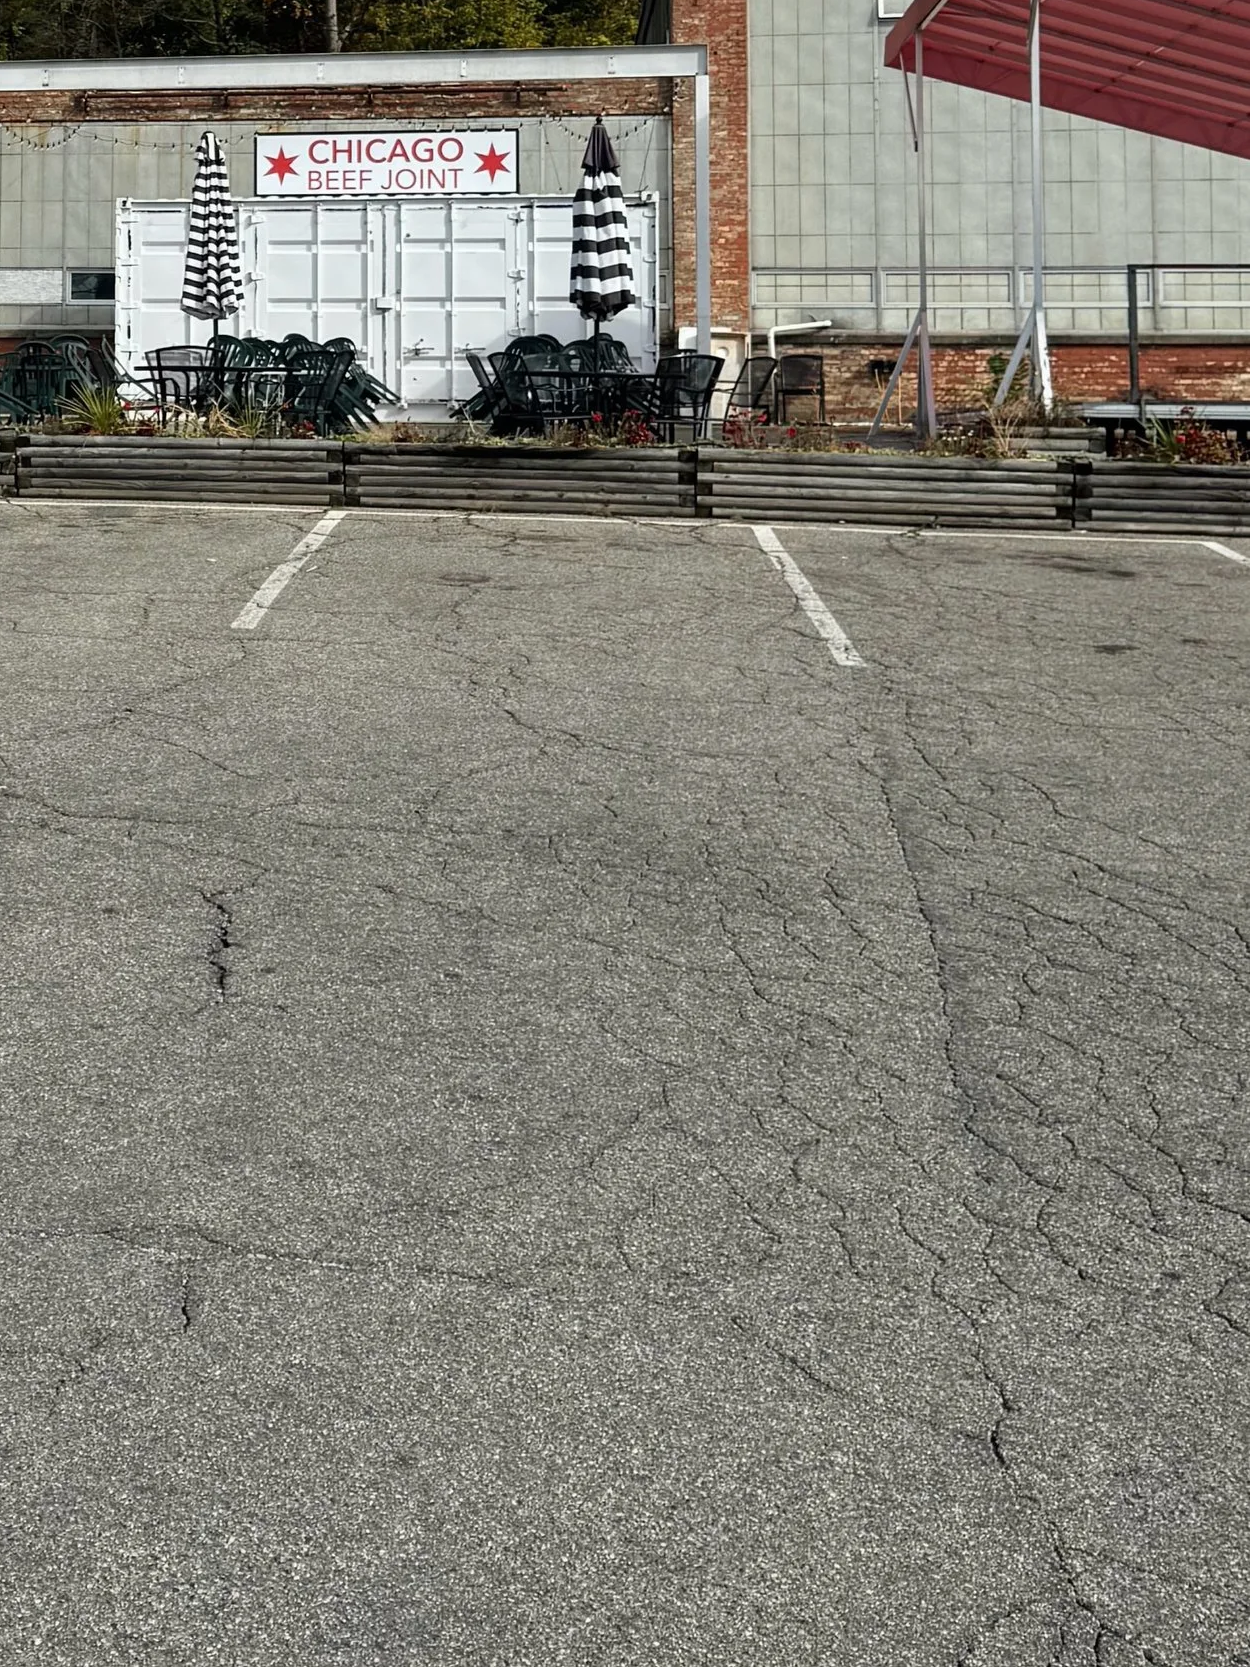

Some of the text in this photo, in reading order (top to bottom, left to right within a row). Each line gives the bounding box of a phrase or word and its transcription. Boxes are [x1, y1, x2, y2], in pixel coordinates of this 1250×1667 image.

[308, 137, 464, 164] CHICAGO
[307, 168, 464, 191] BEEF JOINT
